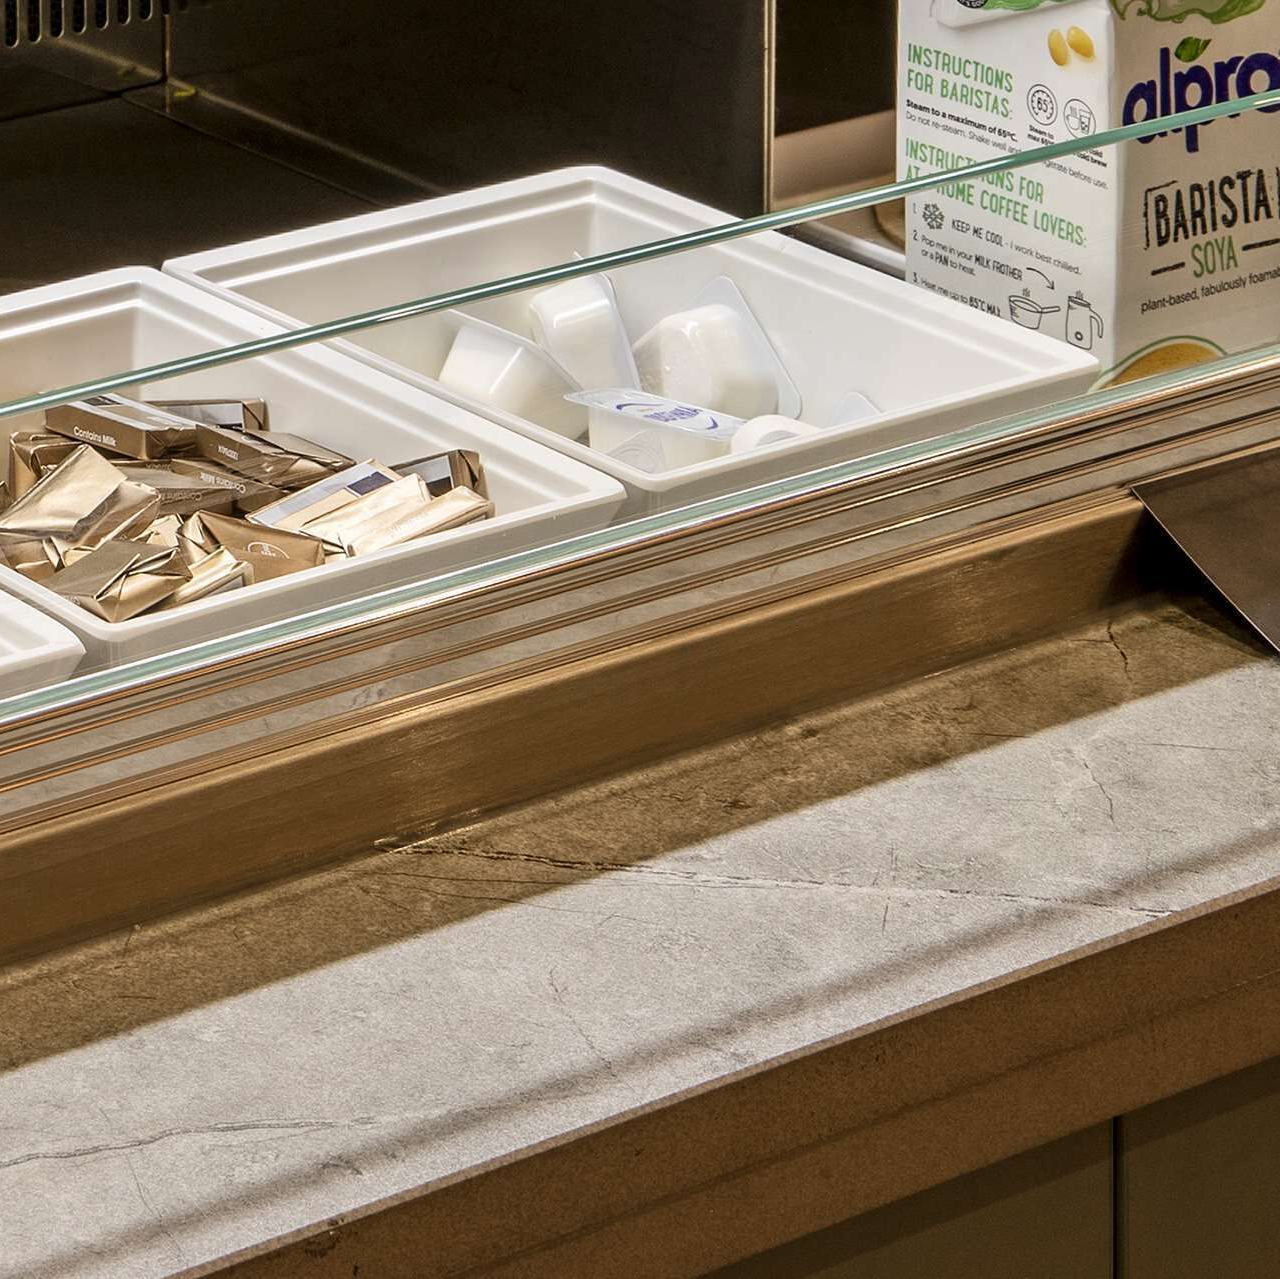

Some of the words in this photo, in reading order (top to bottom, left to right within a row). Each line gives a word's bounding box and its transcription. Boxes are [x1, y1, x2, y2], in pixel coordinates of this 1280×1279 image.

[907, 42, 1014, 93] INSTRUCTIONS
[906, 68, 934, 96] FOR
[940, 78, 1014, 121] BARISTAS:
[1037, 96, 1049, 114] 65
[1122, 46, 1280, 154] alpro
[906, 98, 931, 114] Steam
[931, 105, 941, 117] to
[947, 114, 987, 133] maximum
[987, 124, 997, 135] of
[1019, 175, 1045, 204] FOR
[1154, 168, 1274, 247] BARISTA
[951, 218, 971, 234] KEEP
[972, 225, 984, 240] ME
[985, 230, 1004, 247] COOL
[980, 190, 1030, 226] COFFEE
[1033, 209, 1087, 248] LOVERS:
[935, 251, 950, 267] PAN
[974, 253, 992, 270] MILK
[991, 259, 1023, 282] FROTHER
[1191, 234, 1239, 279] SOYA
[73, 426, 103, 442] Contains
[103, 434, 117, 448] Milk
